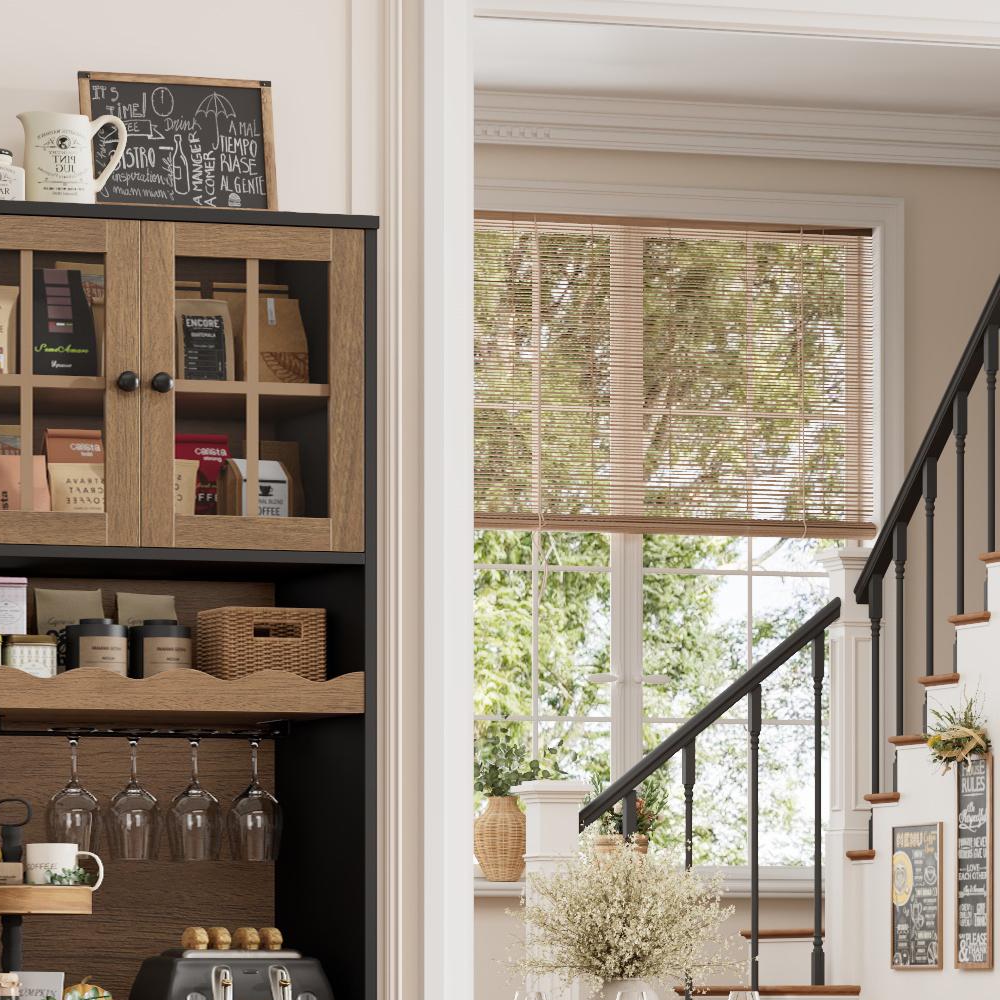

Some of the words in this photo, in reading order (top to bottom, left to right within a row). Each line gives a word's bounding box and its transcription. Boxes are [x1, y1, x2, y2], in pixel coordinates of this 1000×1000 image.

[239, 119, 260, 137] MAL
[220, 135, 258, 158] TIEMPO
[188, 131, 203, 191] MANGER
[203, 150, 216, 195] COMER
[220, 175, 233, 192] AL
[234, 176, 267, 196] GENTE
[186, 318, 220, 328] ENCORE
[259, 507, 280, 516] FFEE
[961, 776, 985, 793] RULES
[967, 864, 980, 872] LOVE
